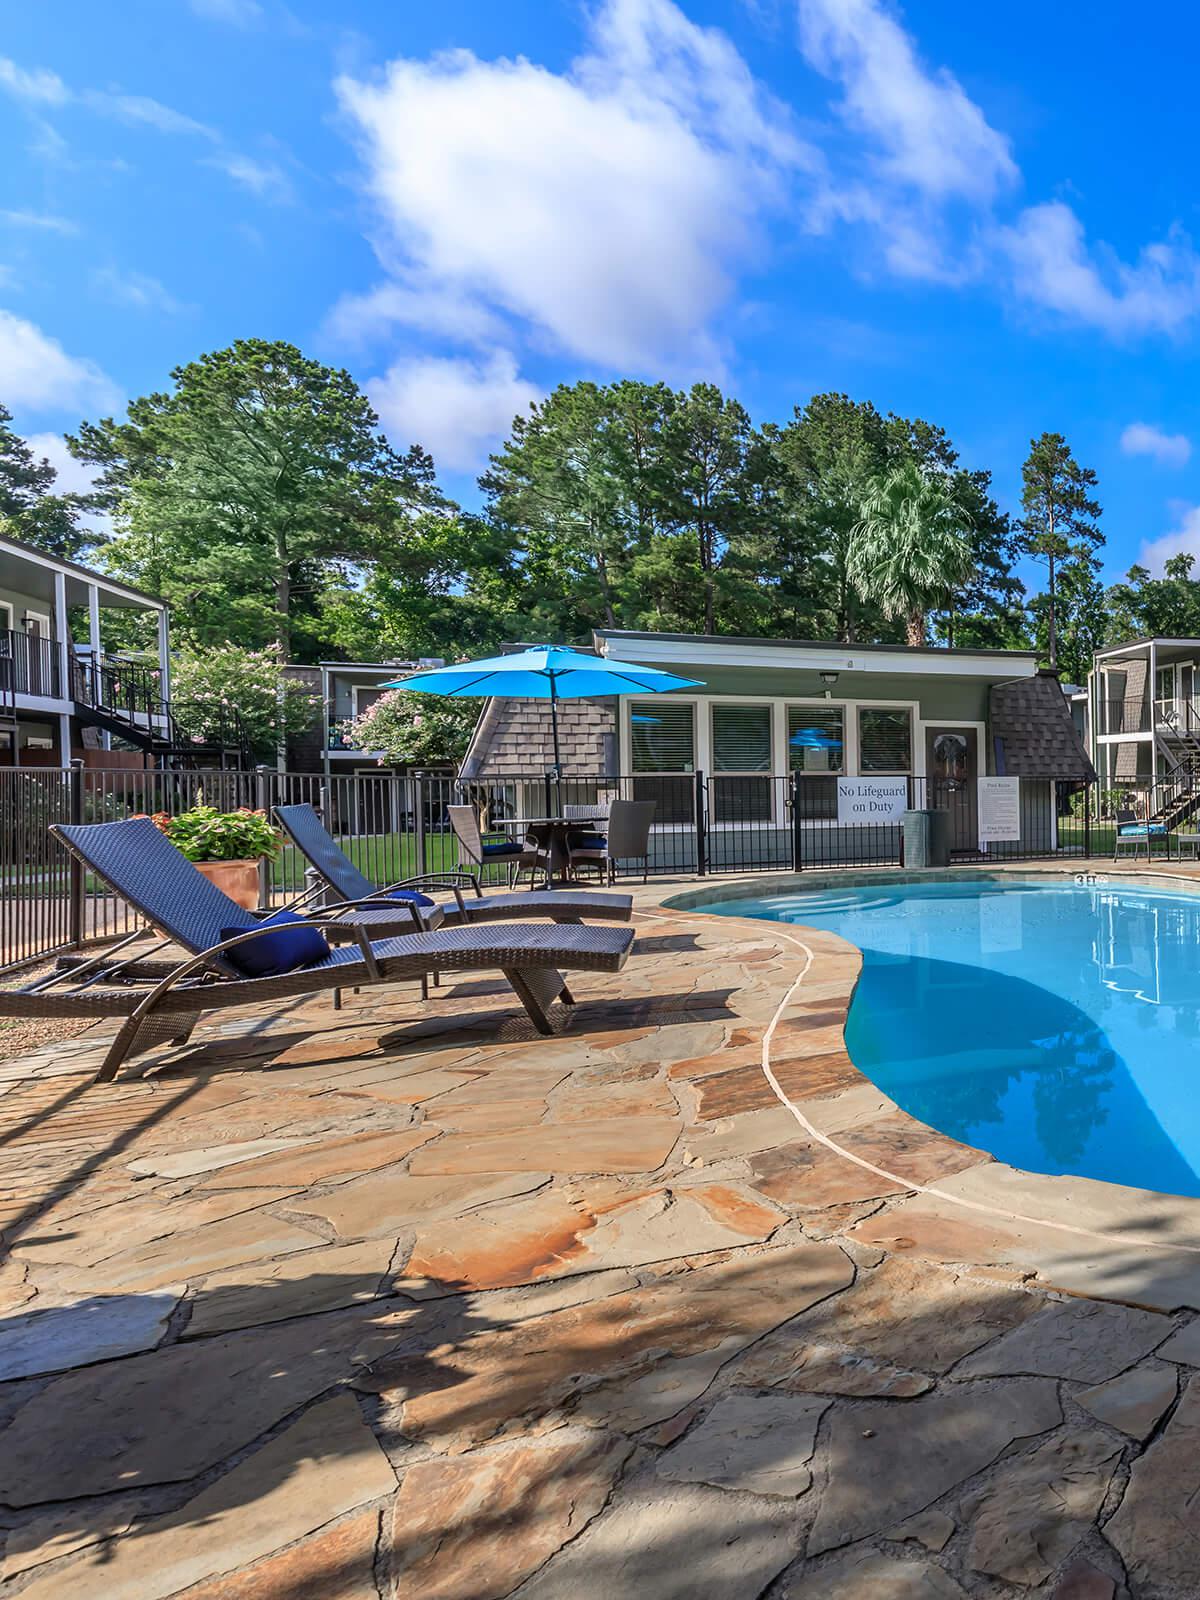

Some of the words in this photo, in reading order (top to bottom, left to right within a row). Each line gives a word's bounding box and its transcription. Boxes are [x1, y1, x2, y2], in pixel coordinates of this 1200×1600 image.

[839, 786, 855, 797] No
[858, 785, 905, 799] Lifeguard
[852, 803, 866, 812] on
[869, 801, 894, 814] Duty
[1076, 874, 1084, 885] 3
[1086, 875, 1097, 885] FT
